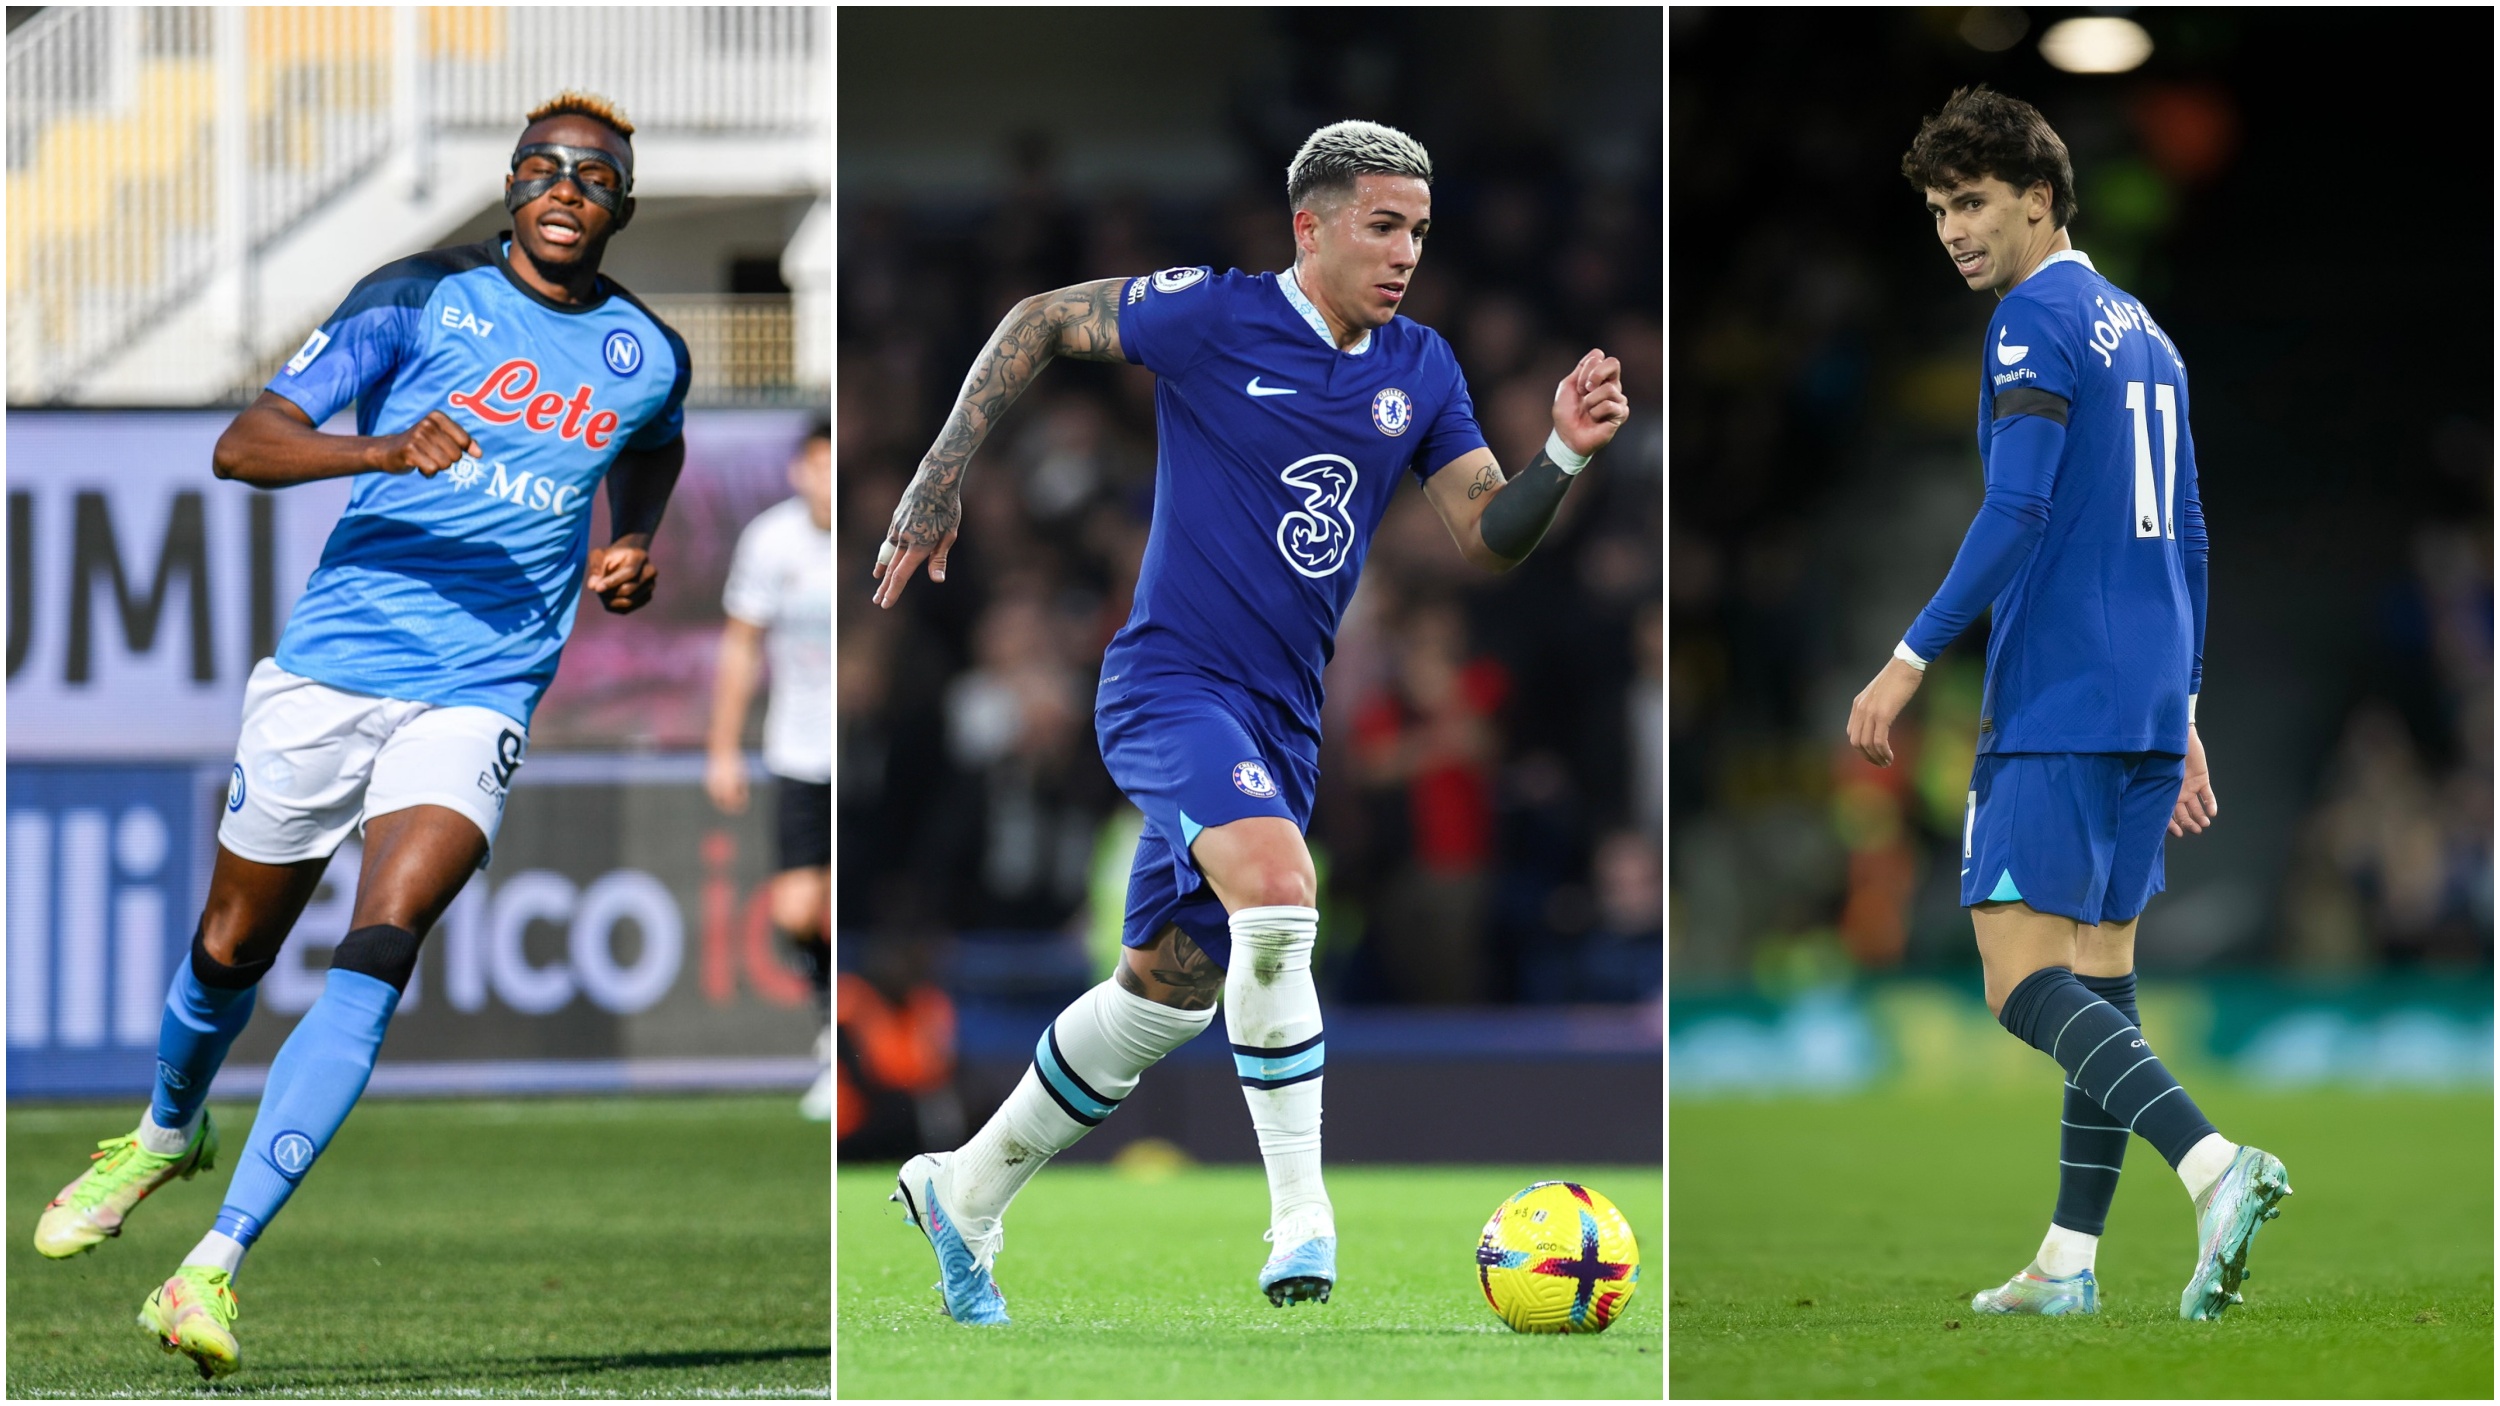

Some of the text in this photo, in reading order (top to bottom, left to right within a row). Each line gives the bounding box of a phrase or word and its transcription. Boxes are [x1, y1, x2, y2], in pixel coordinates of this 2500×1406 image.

[440, 305, 495, 339] EA7
[448, 357, 621, 451] Lete
[1993, 367, 2037, 386] WhaleFin
[484, 460, 582, 517] MSC
[2125, 380, 2178, 541] 11
[491, 727, 523, 789] 9
[2130, 1038, 2150, 1048] CF
